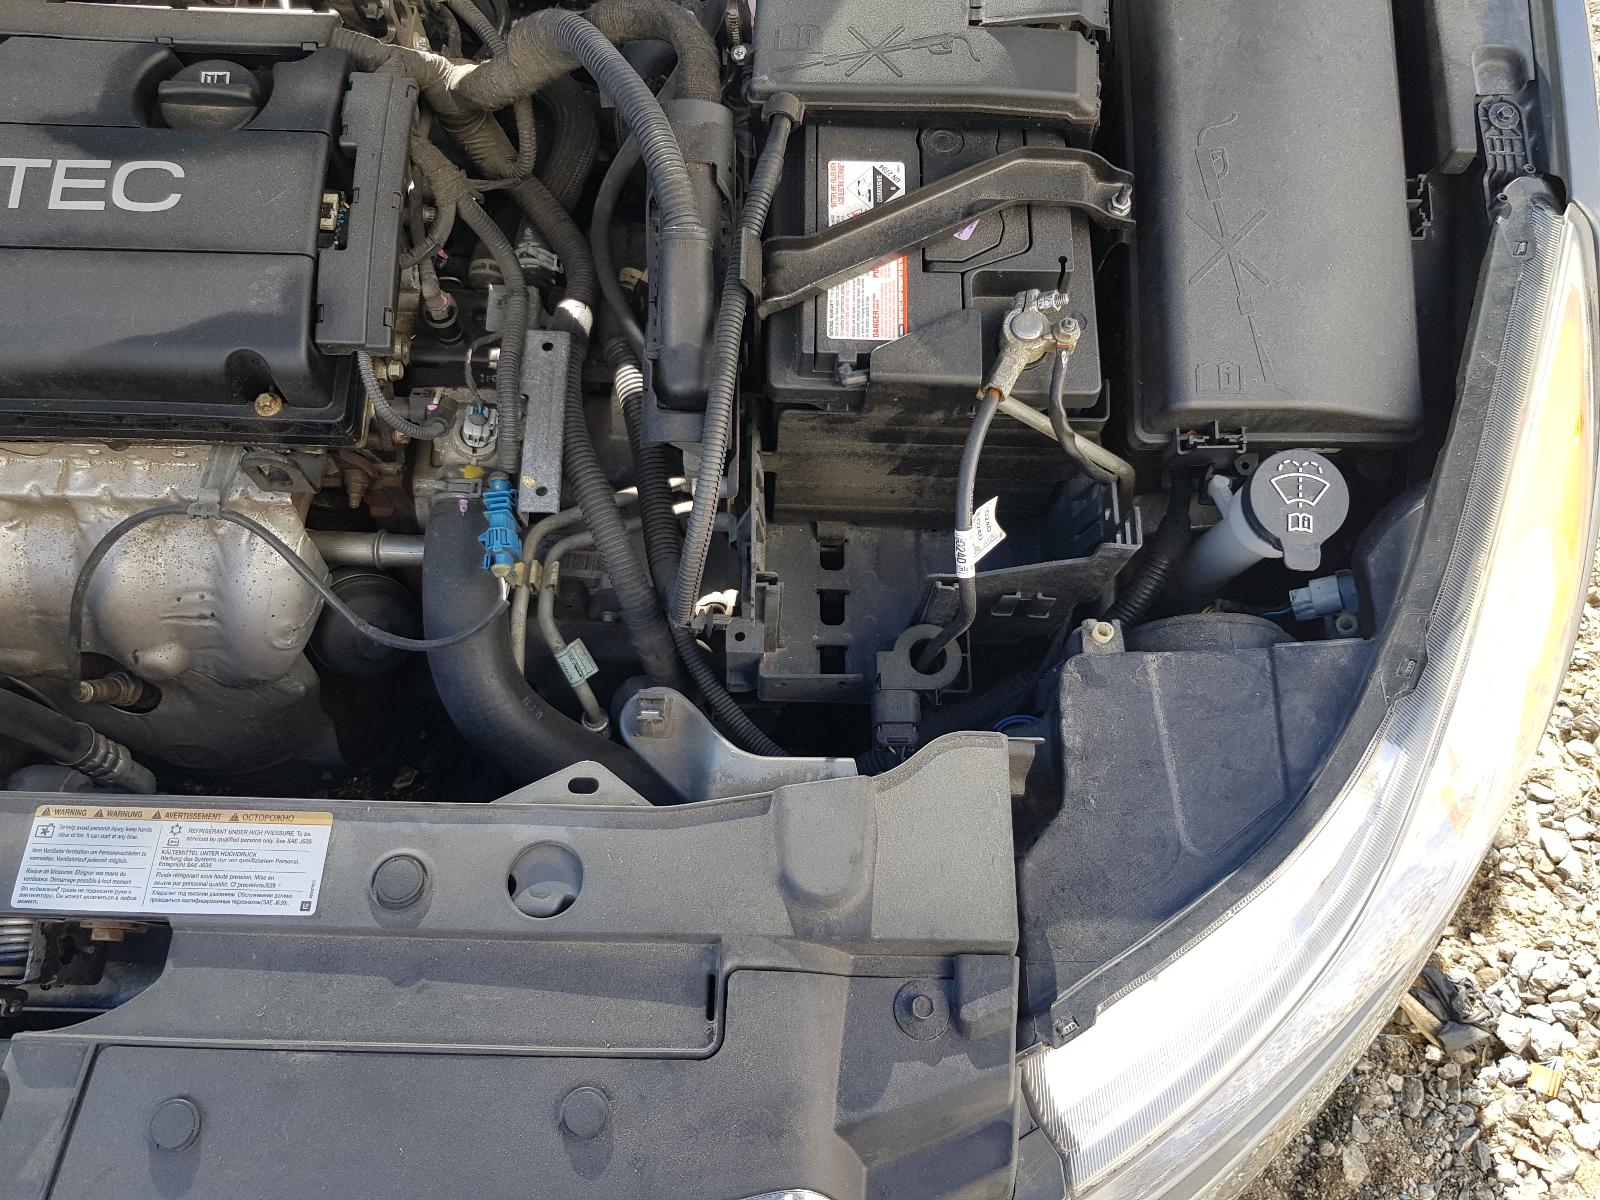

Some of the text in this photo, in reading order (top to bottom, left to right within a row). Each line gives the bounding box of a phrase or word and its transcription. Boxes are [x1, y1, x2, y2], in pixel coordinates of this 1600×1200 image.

[878, 164, 893, 177] 2794
[891, 174, 901, 184] UN
[0, 157, 185, 212] TEC
[872, 310, 880, 338] DANGER
[54, 808, 87, 817] WARNING
[107, 809, 143, 818] WARNUNG
[165, 811, 223, 820] AVERTISSEMENT
[242, 813, 295, 822] ОСТОРОЖНО
[90, 825, 110, 833] personal
[161, 848, 198, 856] KÄLTEMITTEL
